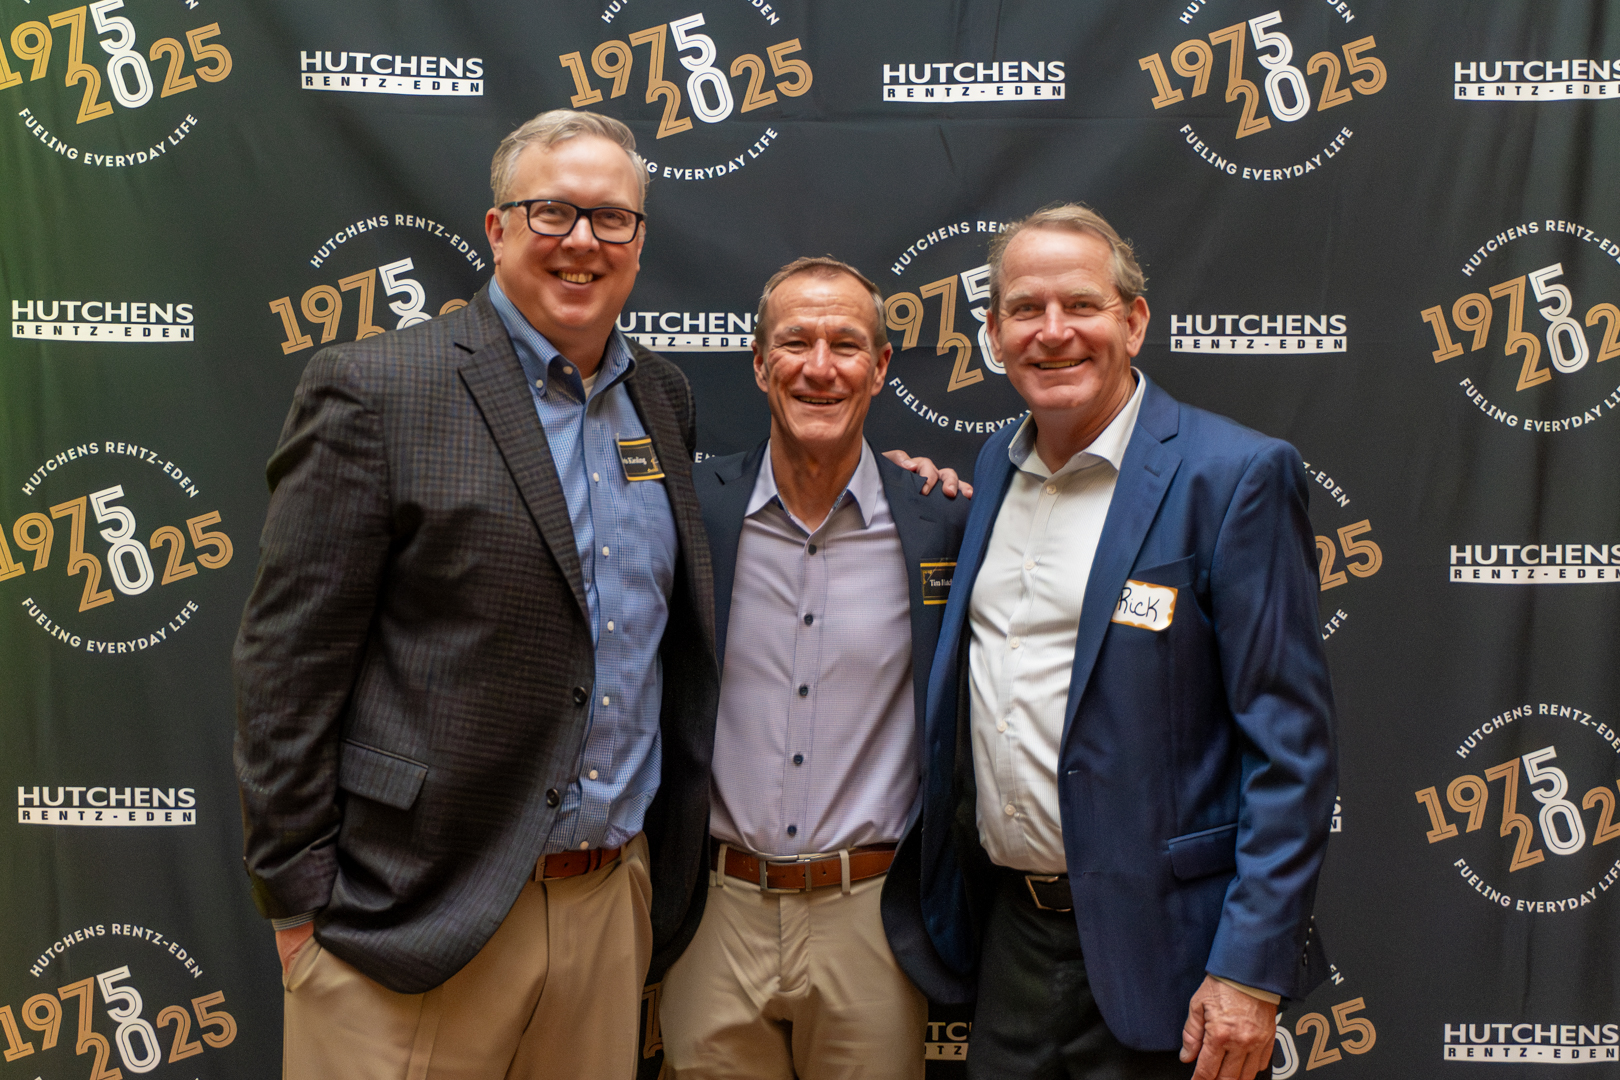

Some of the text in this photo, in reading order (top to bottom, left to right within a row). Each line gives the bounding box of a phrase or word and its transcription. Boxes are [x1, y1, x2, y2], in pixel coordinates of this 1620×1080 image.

[300, 50, 484, 79] HUTCHENS
[883, 61, 1066, 84] HUTCHENS
[305, 76, 480, 93] RENTZ-EDEN
[887, 85, 1062, 98] RENTZ-EDEN
[1458, 84, 1620, 96] RENTZ-EDE
[18, 107, 199, 167] FUELING EVERYDAY LIFE
[662, 154, 746, 181] EVERYDAY
[747, 127, 778, 159] LIFE
[1179, 124, 1353, 181] FUELING EVERYDAY LIFE
[309, 214, 486, 272] HUTCHENS RENTZ-EDEN
[890, 221, 971, 276] HUTCHENS
[1461, 219, 1620, 277] HUTCHENS RENTZ-ED
[12, 299, 195, 324] HUTCHENS
[616, 311, 759, 333] UTCHEN
[1170, 314, 1347, 335] HUTCHENS
[16, 324, 190, 339] RENTZ-EDEN
[1174, 339, 1343, 349] RENTZ-EDEN
[888, 376, 949, 428] FUELING
[1459, 377, 1519, 427] FUELING
[1523, 405, 1602, 432] EVERYDAY
[21, 441, 200, 498] HUTCHENS RENTZ-EDEN
[21, 597, 199, 654] FUELING EVERYDAY LIFE
[1456, 703, 1620, 759] HUTCHENS RENTZ-EDE
[17, 786, 196, 808] HUTCHENS
[22, 810, 192, 822] RENTZ-EDEN
[1453, 858, 1511, 907] FUELING
[1516, 887, 1597, 913] EVERYDAY
[29, 923, 203, 979] HUTCHENS RENTZ-EDEN
[1444, 1023, 1620, 1045] HUTCHENS
[1448, 1047, 1615, 1059] RENTZ-EDEN
